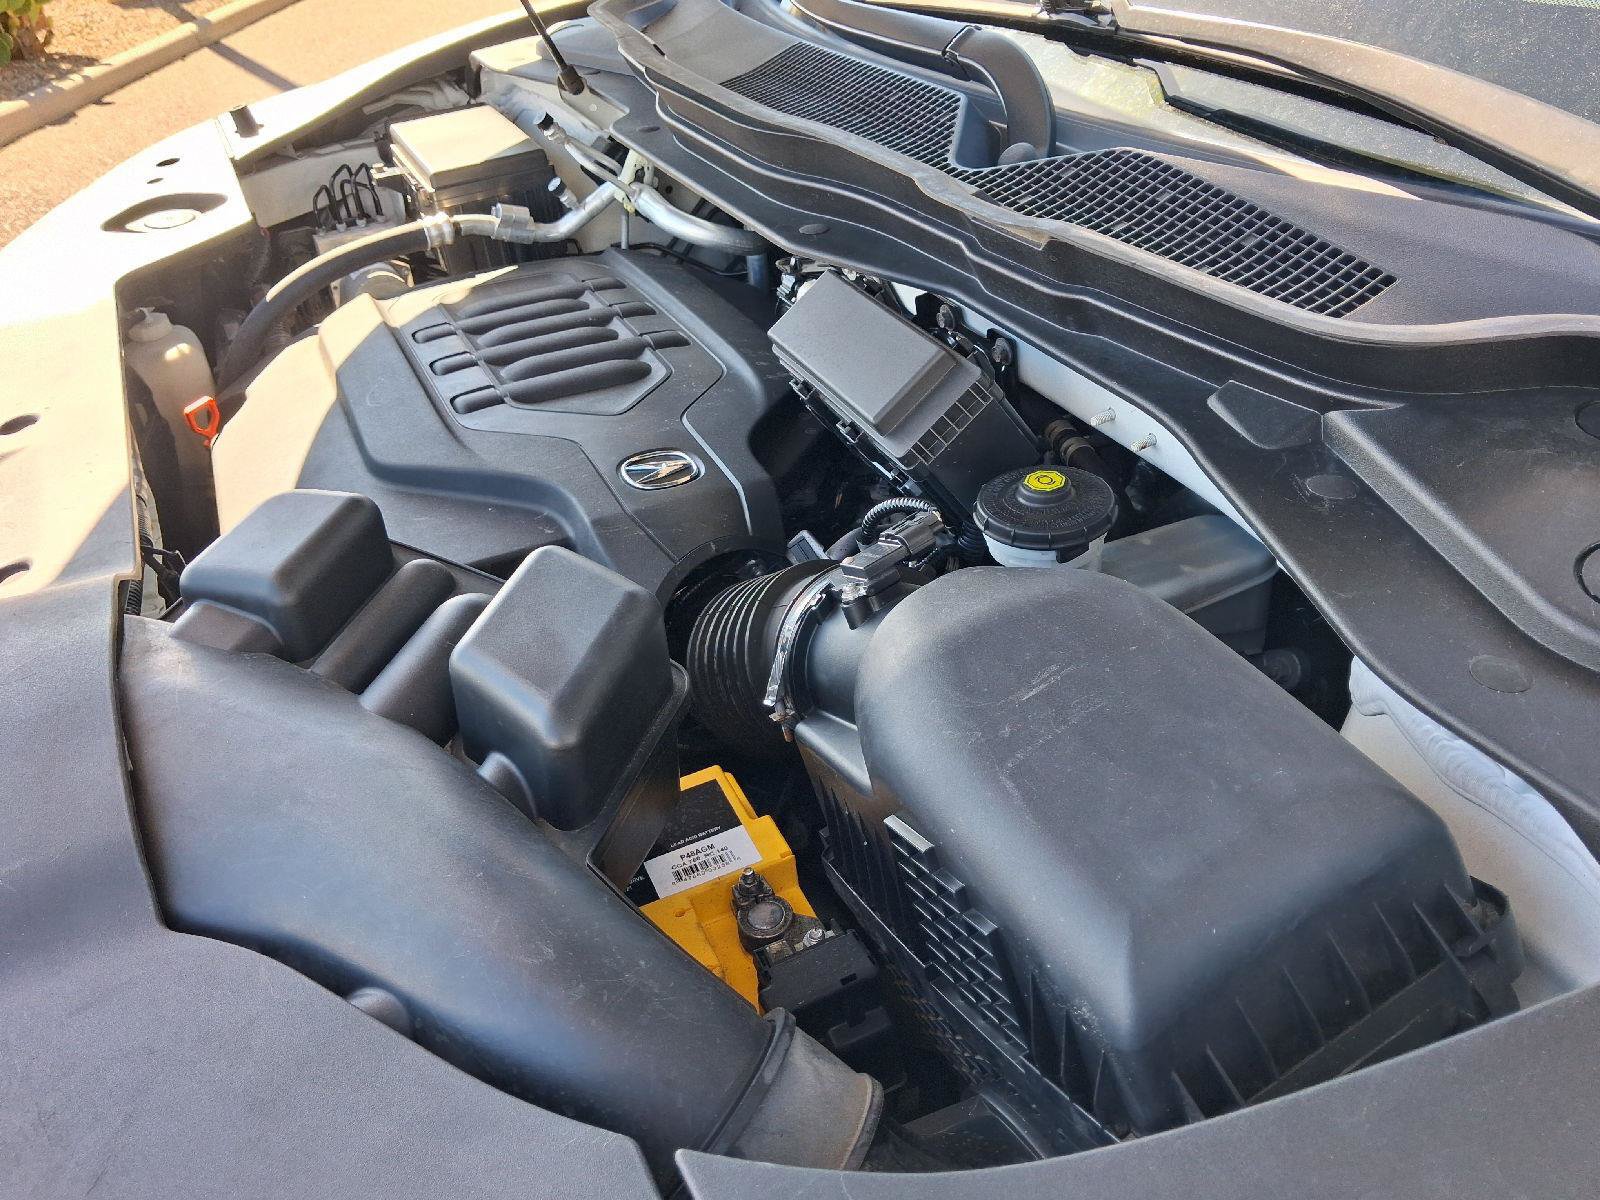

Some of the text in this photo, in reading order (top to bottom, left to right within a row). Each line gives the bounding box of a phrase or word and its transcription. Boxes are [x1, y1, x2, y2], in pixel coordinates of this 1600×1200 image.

[685, 834, 698, 842] ACID
[698, 826, 721, 837] BATTERY
[680, 843, 716, 861] P48AGM
[671, 861, 688, 870] CCA
